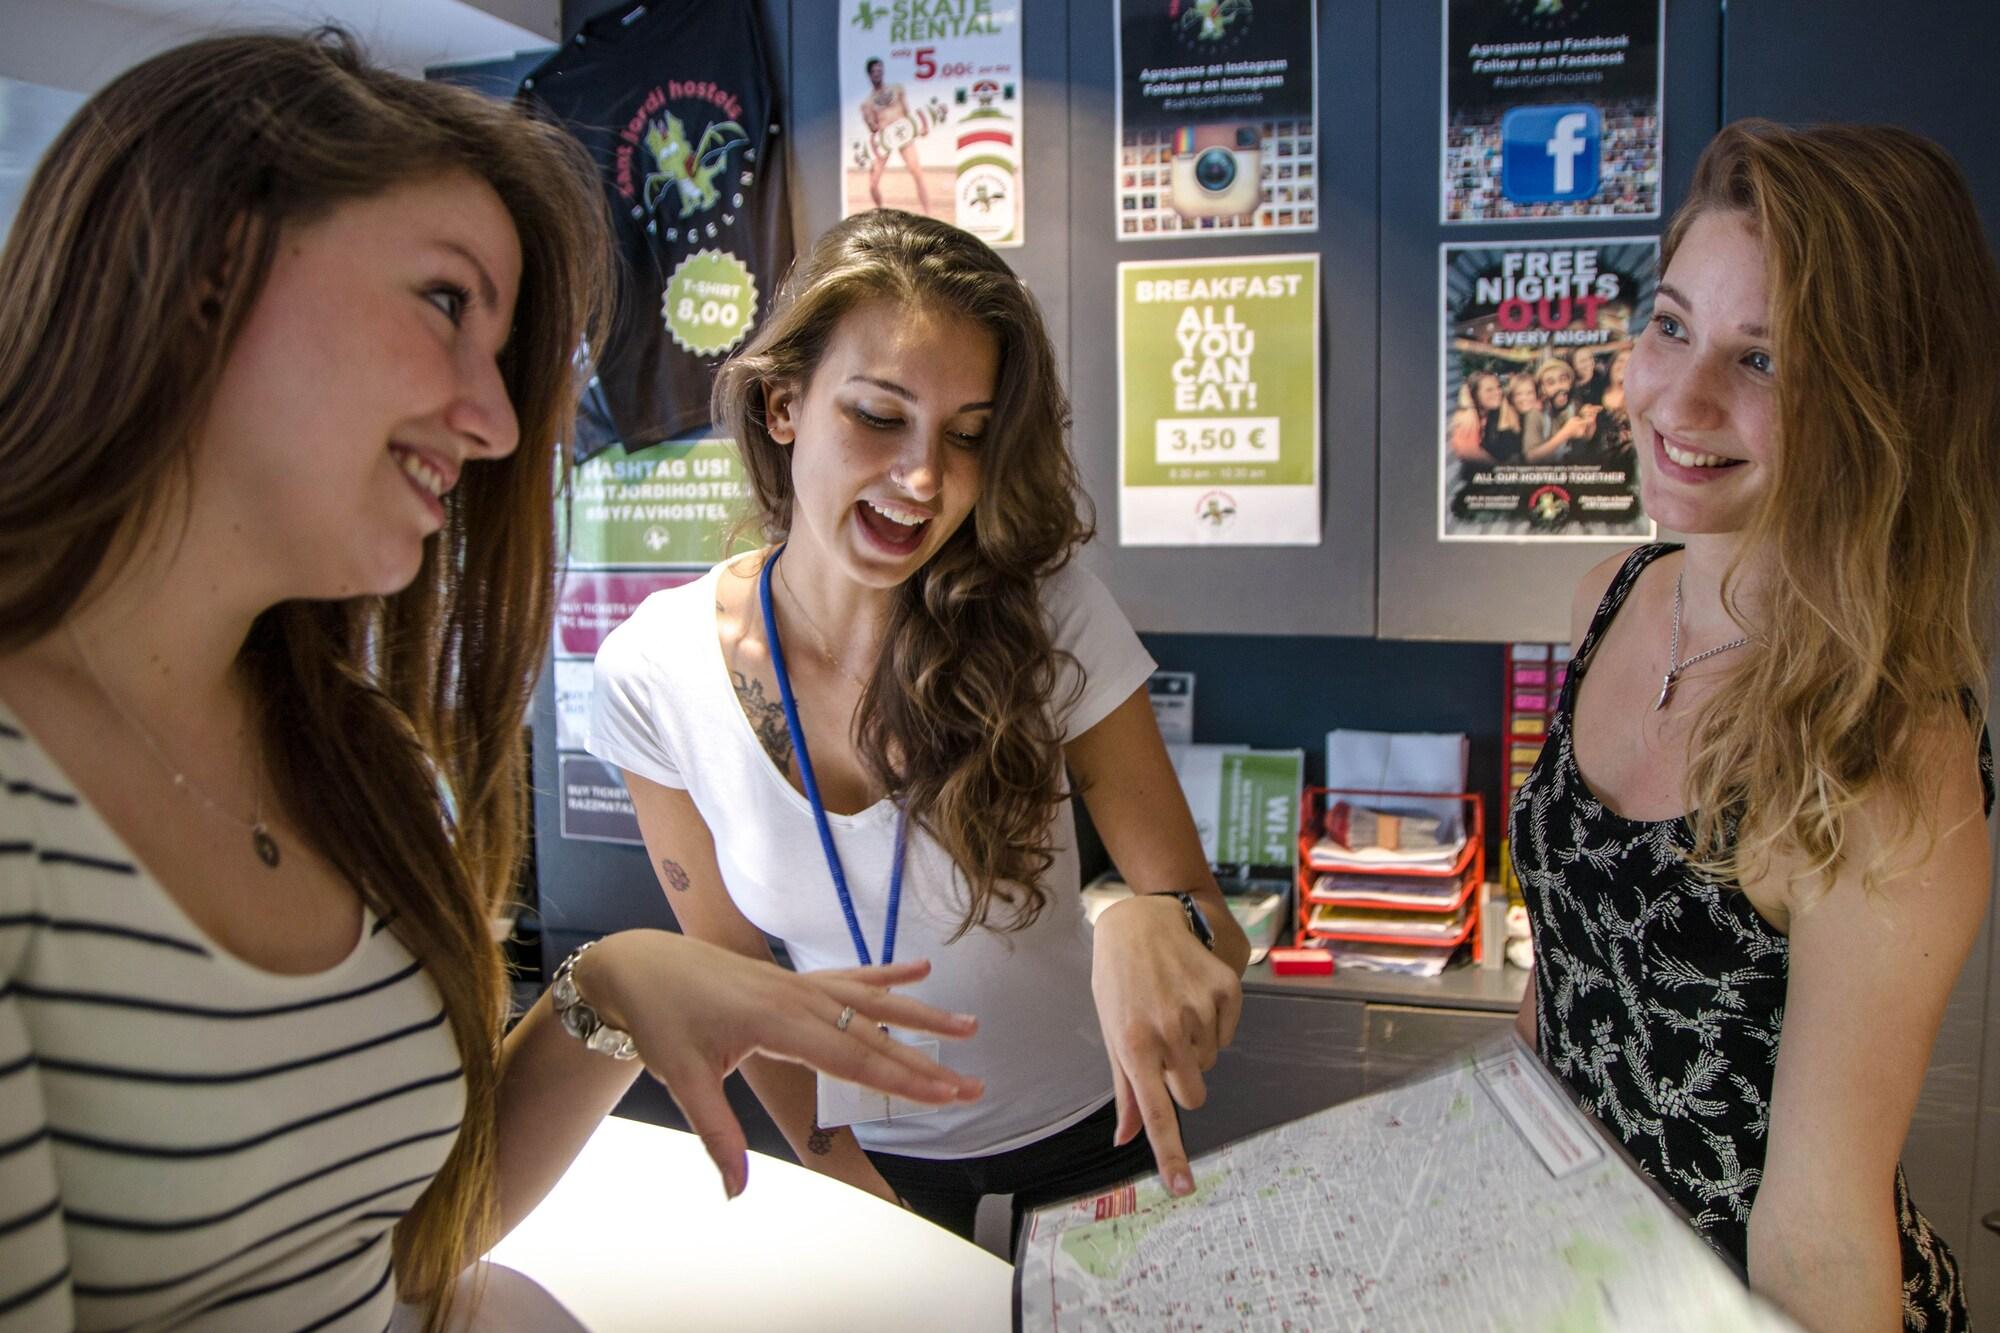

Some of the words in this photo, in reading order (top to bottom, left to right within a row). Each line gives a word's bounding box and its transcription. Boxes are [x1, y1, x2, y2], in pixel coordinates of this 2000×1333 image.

[893, 0, 993, 20] SKATE
[890, 12, 1002, 43] RENTAL
[1562, 34, 1630, 50] Facebook
[1224, 59, 1288, 75] Instagram
[1472, 58, 1518, 74] Follow
[1519, 57, 1537, 71] us
[1537, 56, 1557, 70] on
[1558, 51, 1625, 67] Facebook
[1143, 82, 1185, 97] Follow
[1185, 80, 1201, 94] us
[1203, 79, 1220, 92] on
[1220, 75, 1285, 91] Instagram
[668, 79, 743, 121] hostels
[1503, 251, 1597, 276] FREE
[1136, 275, 1301, 302] BREAKFAST
[1476, 273, 1620, 305] NIGHTS
[677, 298, 739, 328] 8,00
[1179, 305, 1245, 331] ALL
[1498, 296, 1607, 330] OUT
[1175, 329, 1255, 359] YOU
[1492, 331, 1550, 347] EVERY
[1552, 329, 1610, 345] NIGHT
[1171, 356, 1250, 385] CAN
[1174, 382, 1258, 411] EAT!
[1171, 427, 1236, 455] 3,50
[1247, 427, 1266, 450] €
[692, 458, 731, 478] US!
[1475, 472, 1495, 484] ALL
[1568, 471, 1626, 483] TOGETHER
[592, 786, 629, 799] TICKET
[1266, 796, 1289, 862] WI-F
